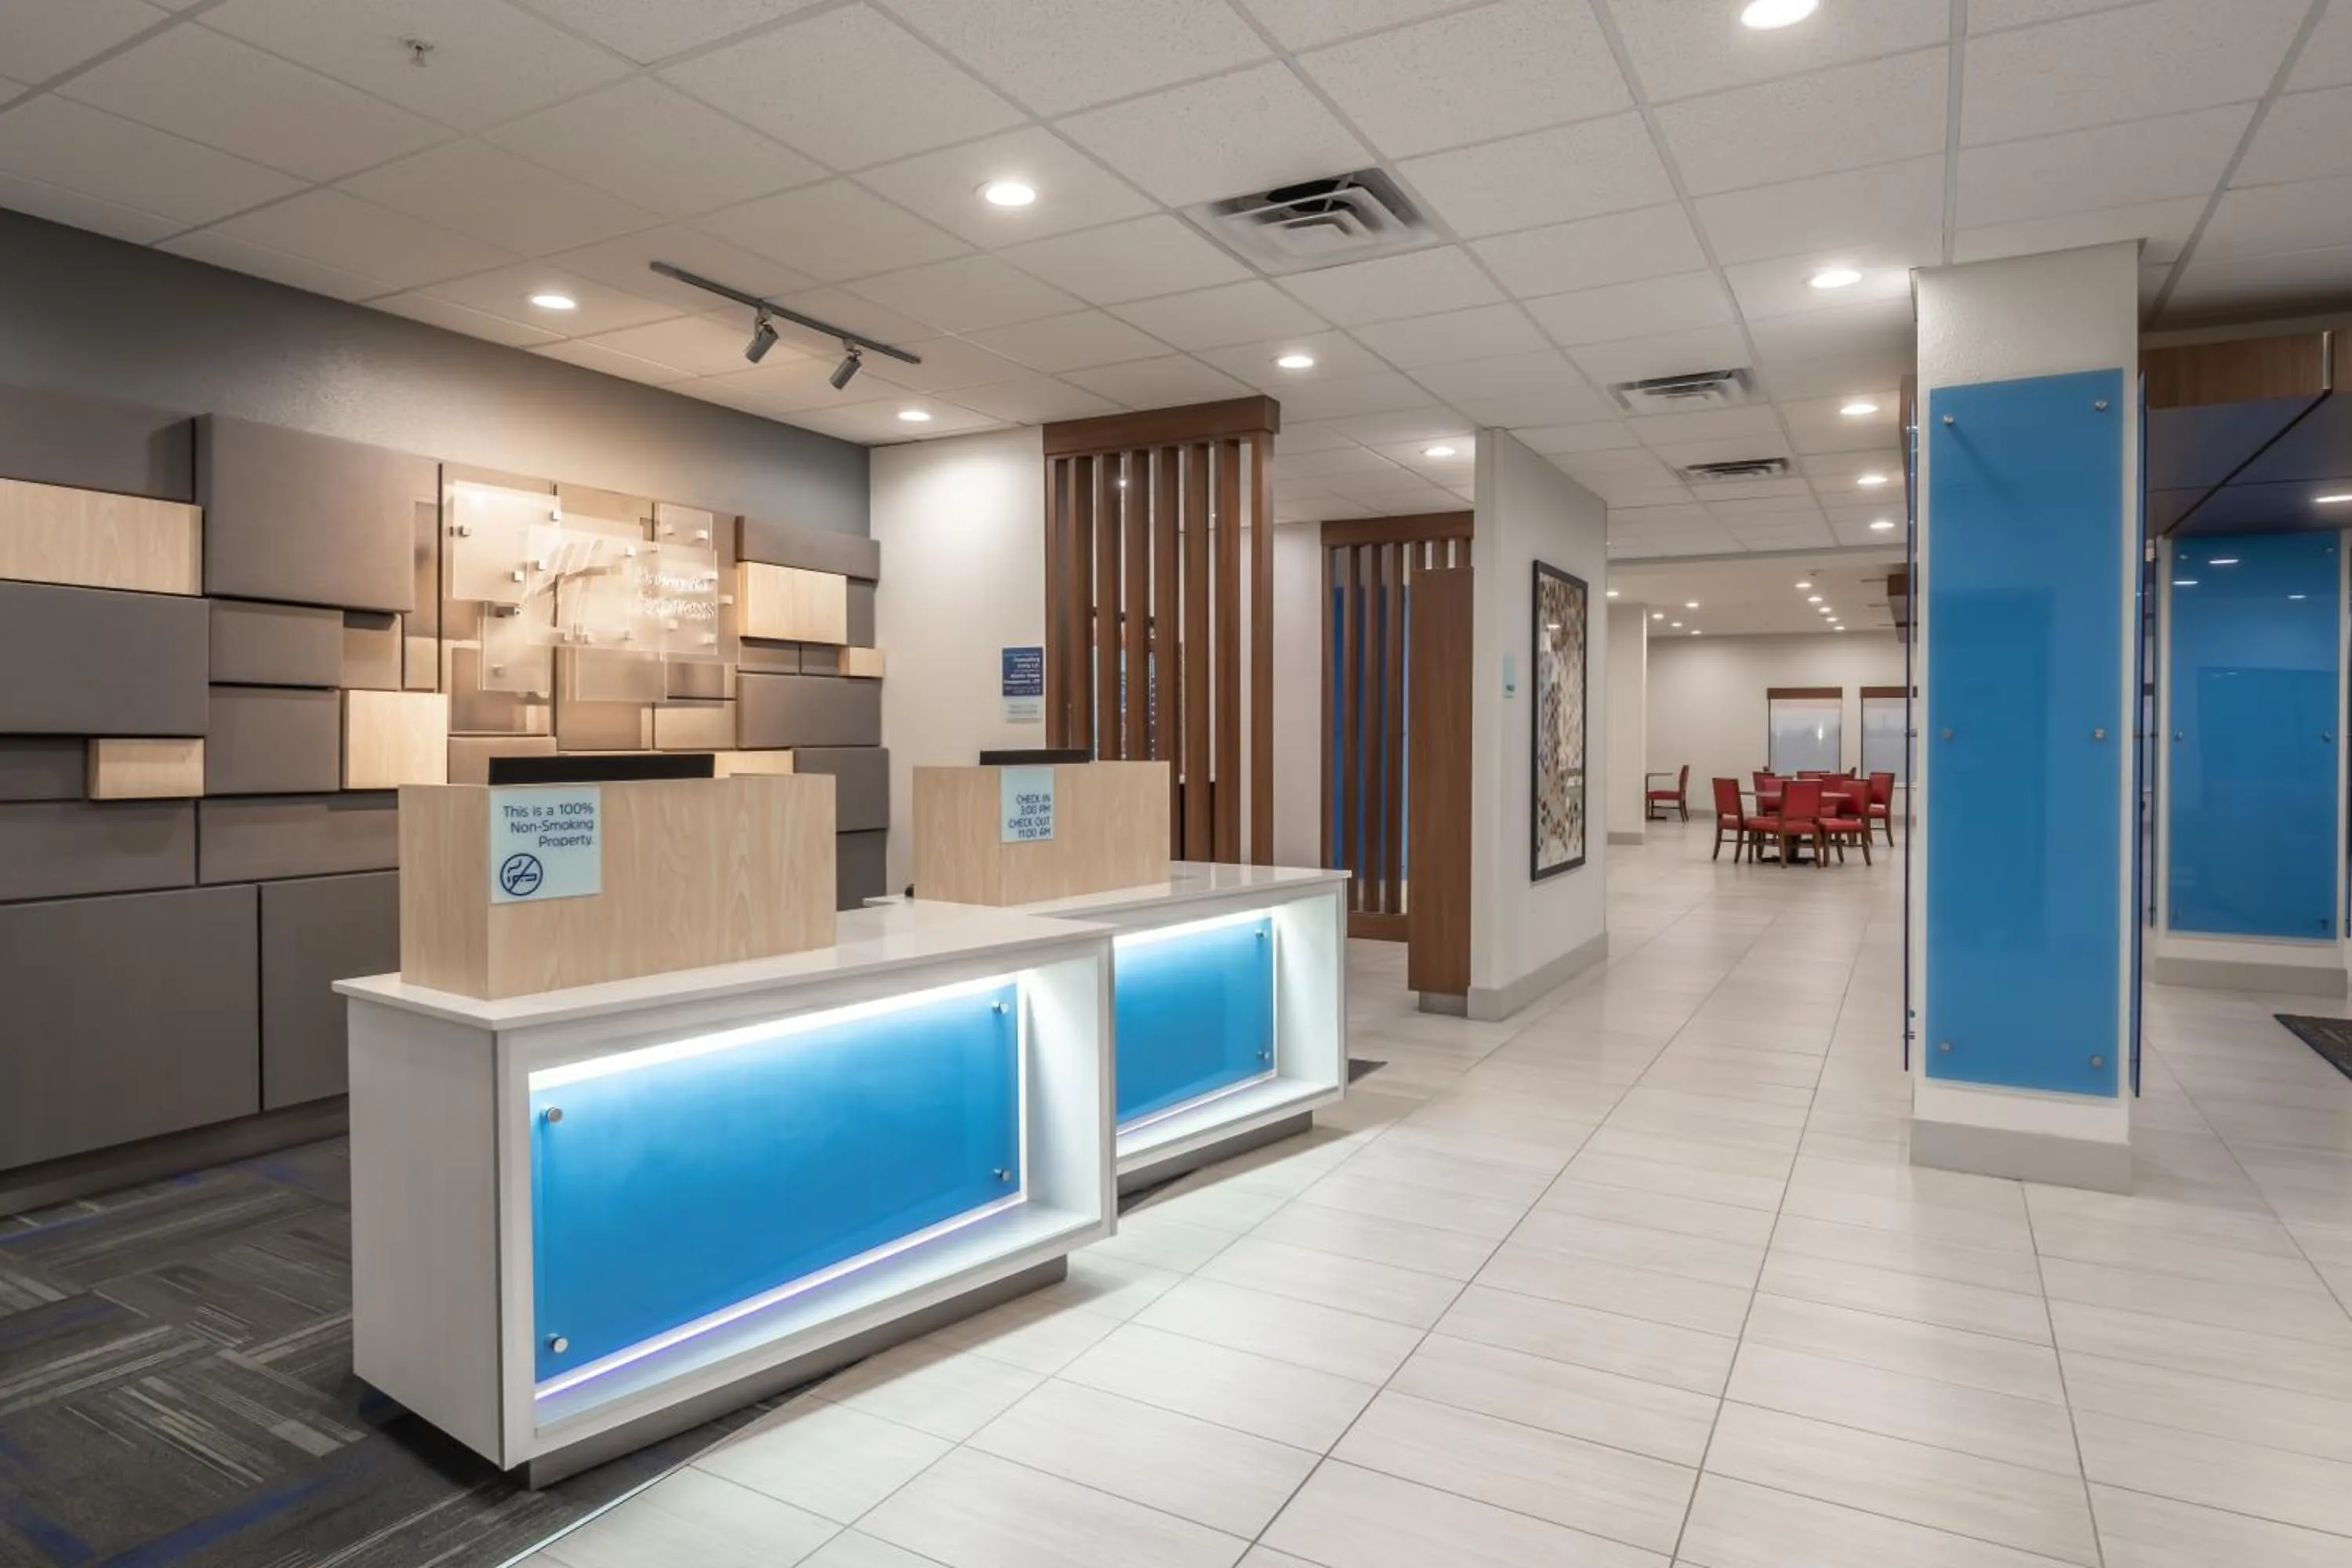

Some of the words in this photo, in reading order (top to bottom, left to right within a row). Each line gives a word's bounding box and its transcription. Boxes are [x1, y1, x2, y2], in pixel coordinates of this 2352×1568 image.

[1016, 794, 1040, 805] CHECK
[1043, 793, 1051, 802] IN
[503, 805, 528, 818] This
[532, 805, 542, 817] is
[546, 808, 554, 816] a
[559, 803, 593, 815] 100%
[1039, 804, 1051, 814] PM
[510, 819, 593, 833] Non-Smoking
[1008, 818, 1033, 829] CHECK
[1034, 816, 1050, 827] OUT
[1039, 827, 1051, 837] AM
